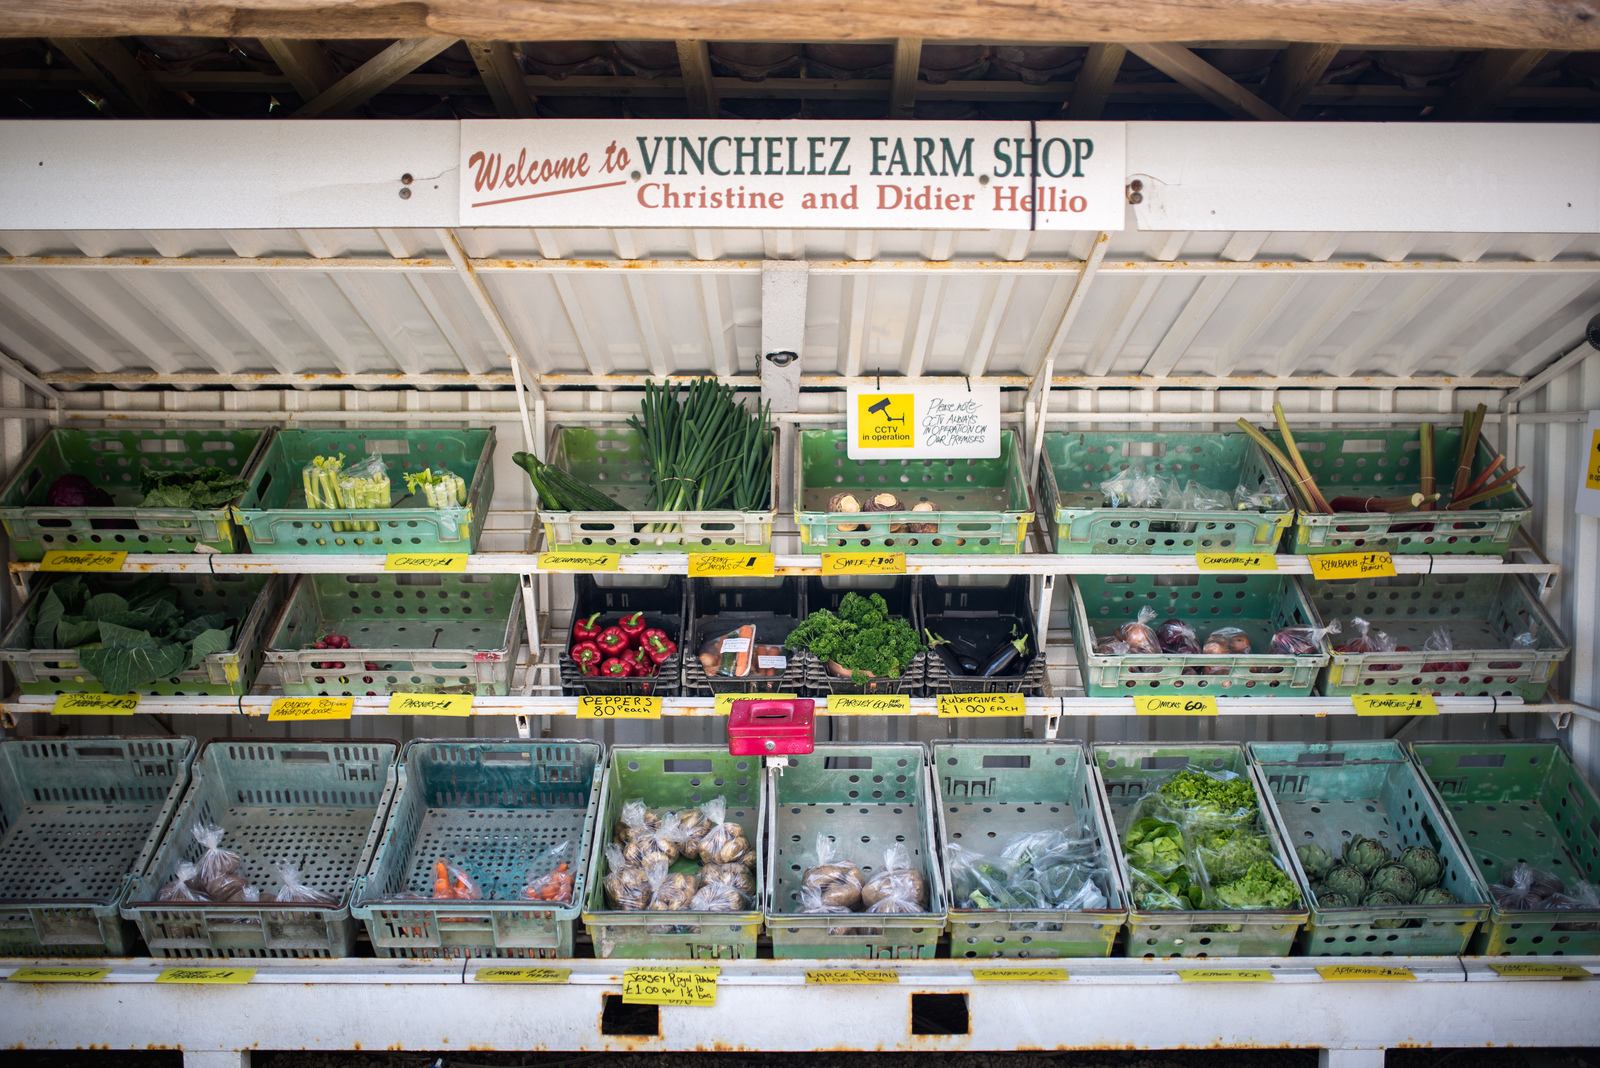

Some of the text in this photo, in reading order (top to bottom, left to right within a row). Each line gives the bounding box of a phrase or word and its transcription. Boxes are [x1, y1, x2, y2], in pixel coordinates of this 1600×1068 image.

[469, 139, 631, 193] Welcome to
[637, 136, 1094, 178] VINCHELEZ FARM SHOP
[637, 182, 1088, 213] Christine and Didier Hellio
[926, 398, 955, 415] Please
[582, 696, 653, 707] PEPPERS
[624, 973, 666, 983] JERSEY
